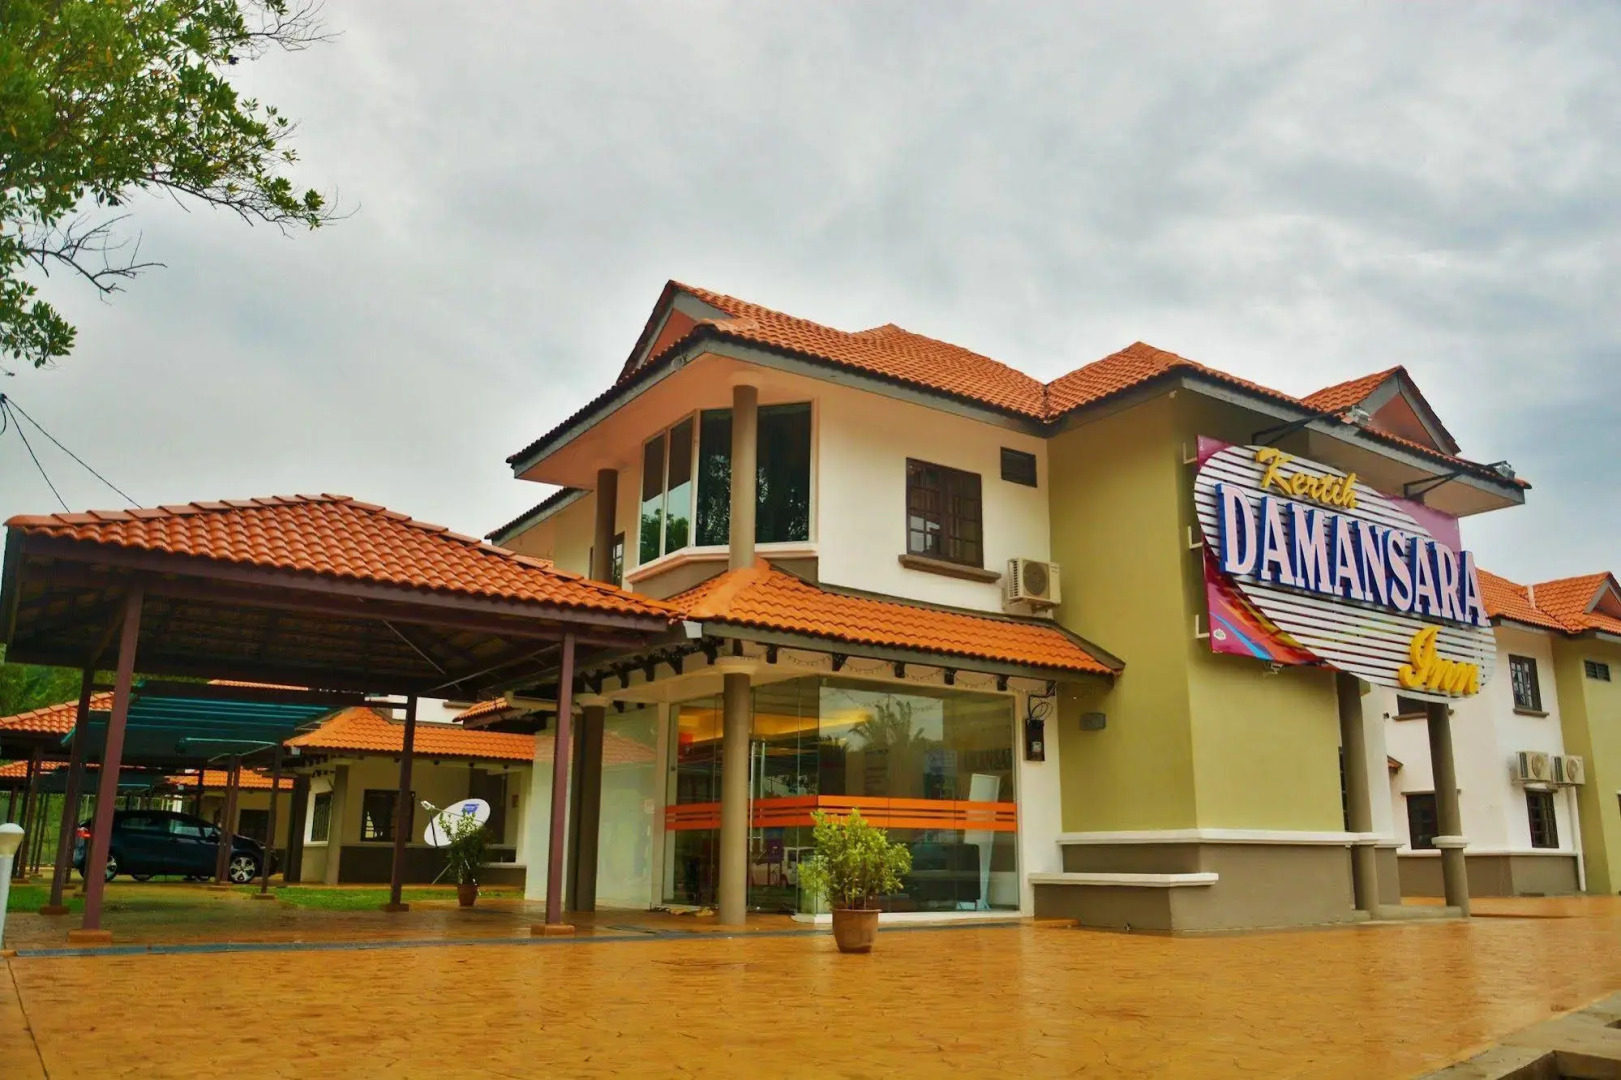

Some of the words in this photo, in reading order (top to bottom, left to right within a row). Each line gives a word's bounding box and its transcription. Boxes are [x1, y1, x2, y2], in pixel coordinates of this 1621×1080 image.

[1255, 448, 1358, 509] Kertih
[1215, 483, 1490, 626] DAMANSARA
[1398, 626, 1479, 695] Inn
